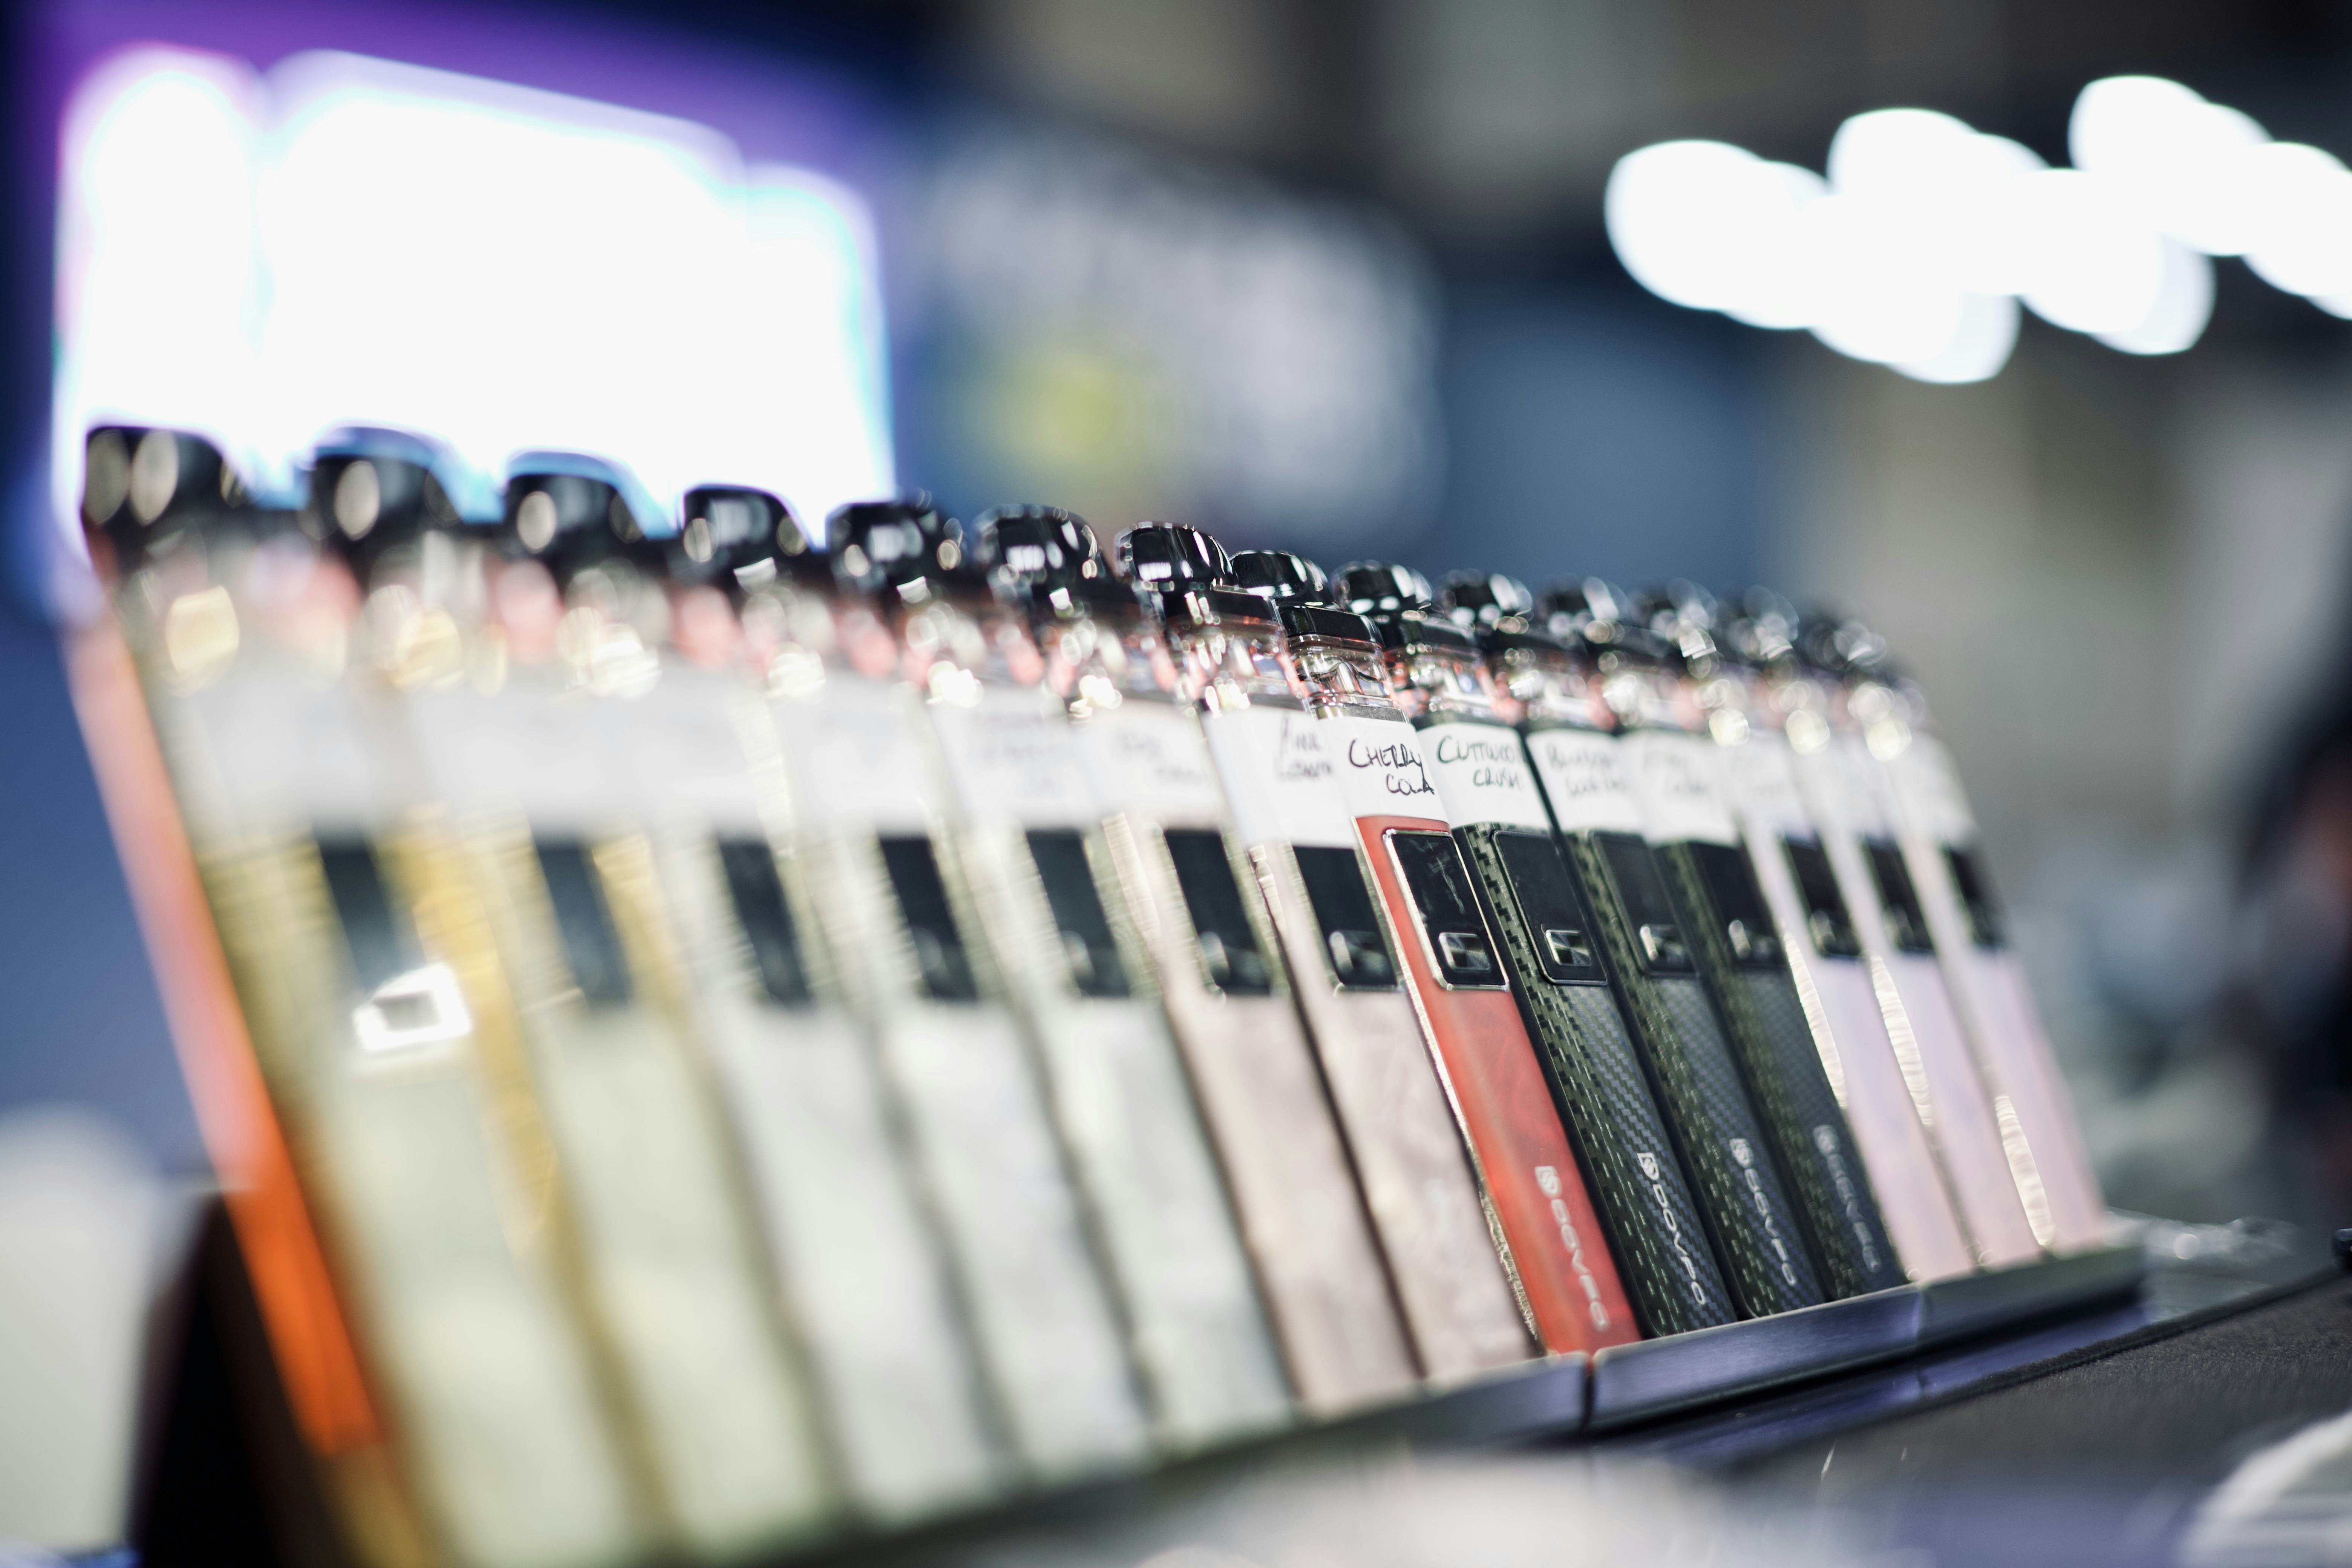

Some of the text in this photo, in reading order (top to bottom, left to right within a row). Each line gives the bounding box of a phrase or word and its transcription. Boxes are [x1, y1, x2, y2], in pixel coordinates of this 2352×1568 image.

[1473, 767, 1521, 792] CRUSH
[1551, 1199, 1610, 1331] DOVPO
[1653, 1184, 1705, 1305] DOVPO
[1744, 1168, 1797, 1286] DOVPO
